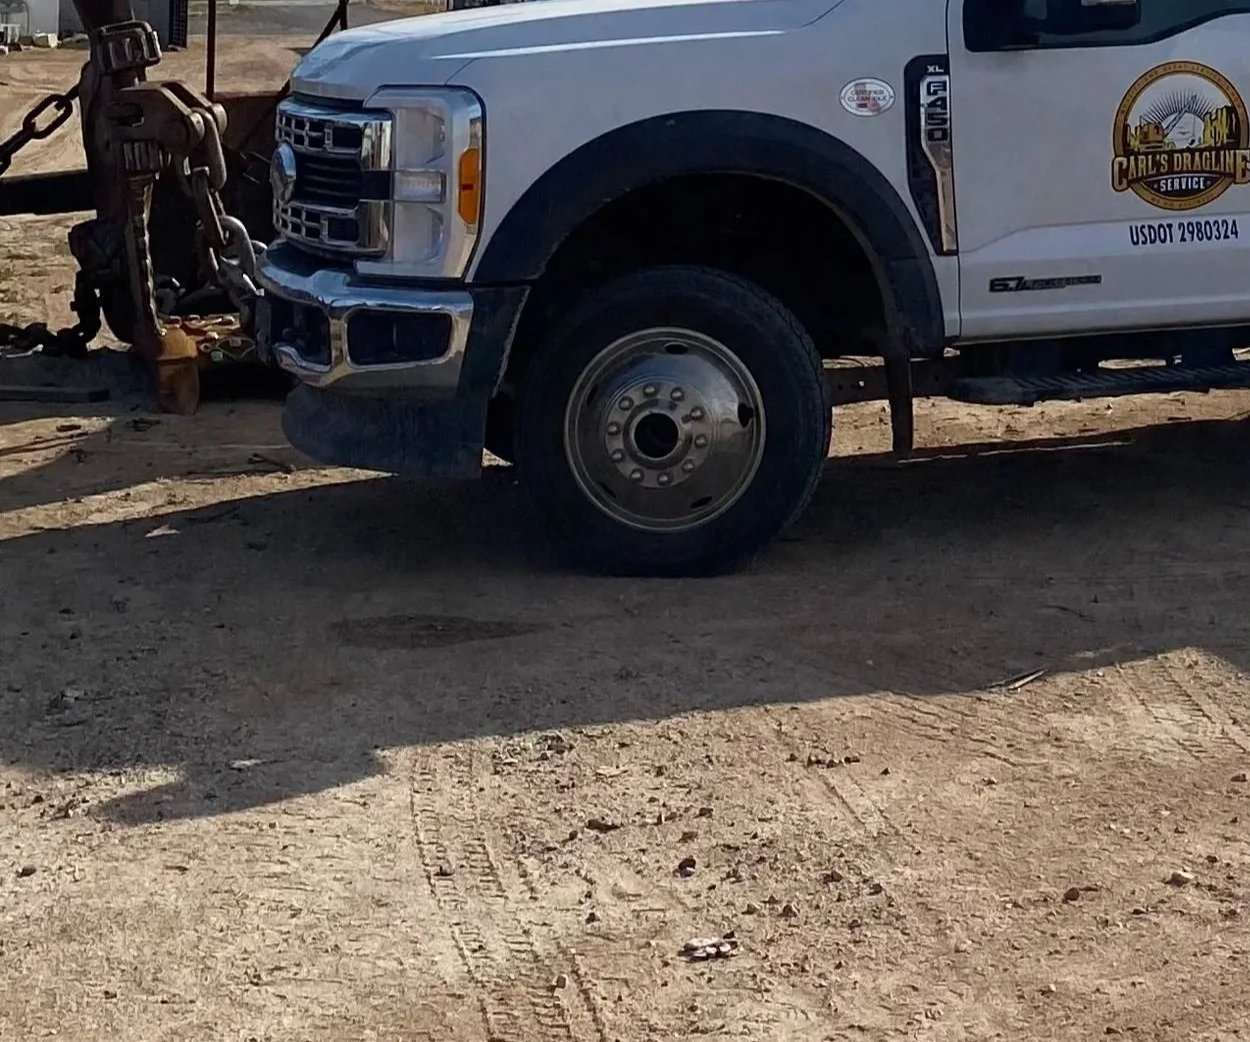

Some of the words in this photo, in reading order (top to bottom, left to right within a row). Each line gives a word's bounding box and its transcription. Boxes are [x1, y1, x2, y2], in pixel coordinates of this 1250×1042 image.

[927, 65, 944, 73] XL
[1112, 152, 1168, 192] CARL'S
[1173, 149, 1250, 184] DRAGLINE
[1160, 177, 1205, 192] SERVICE
[1129, 223, 1173, 246] USDOT
[1178, 219, 1239, 243] 2980324
